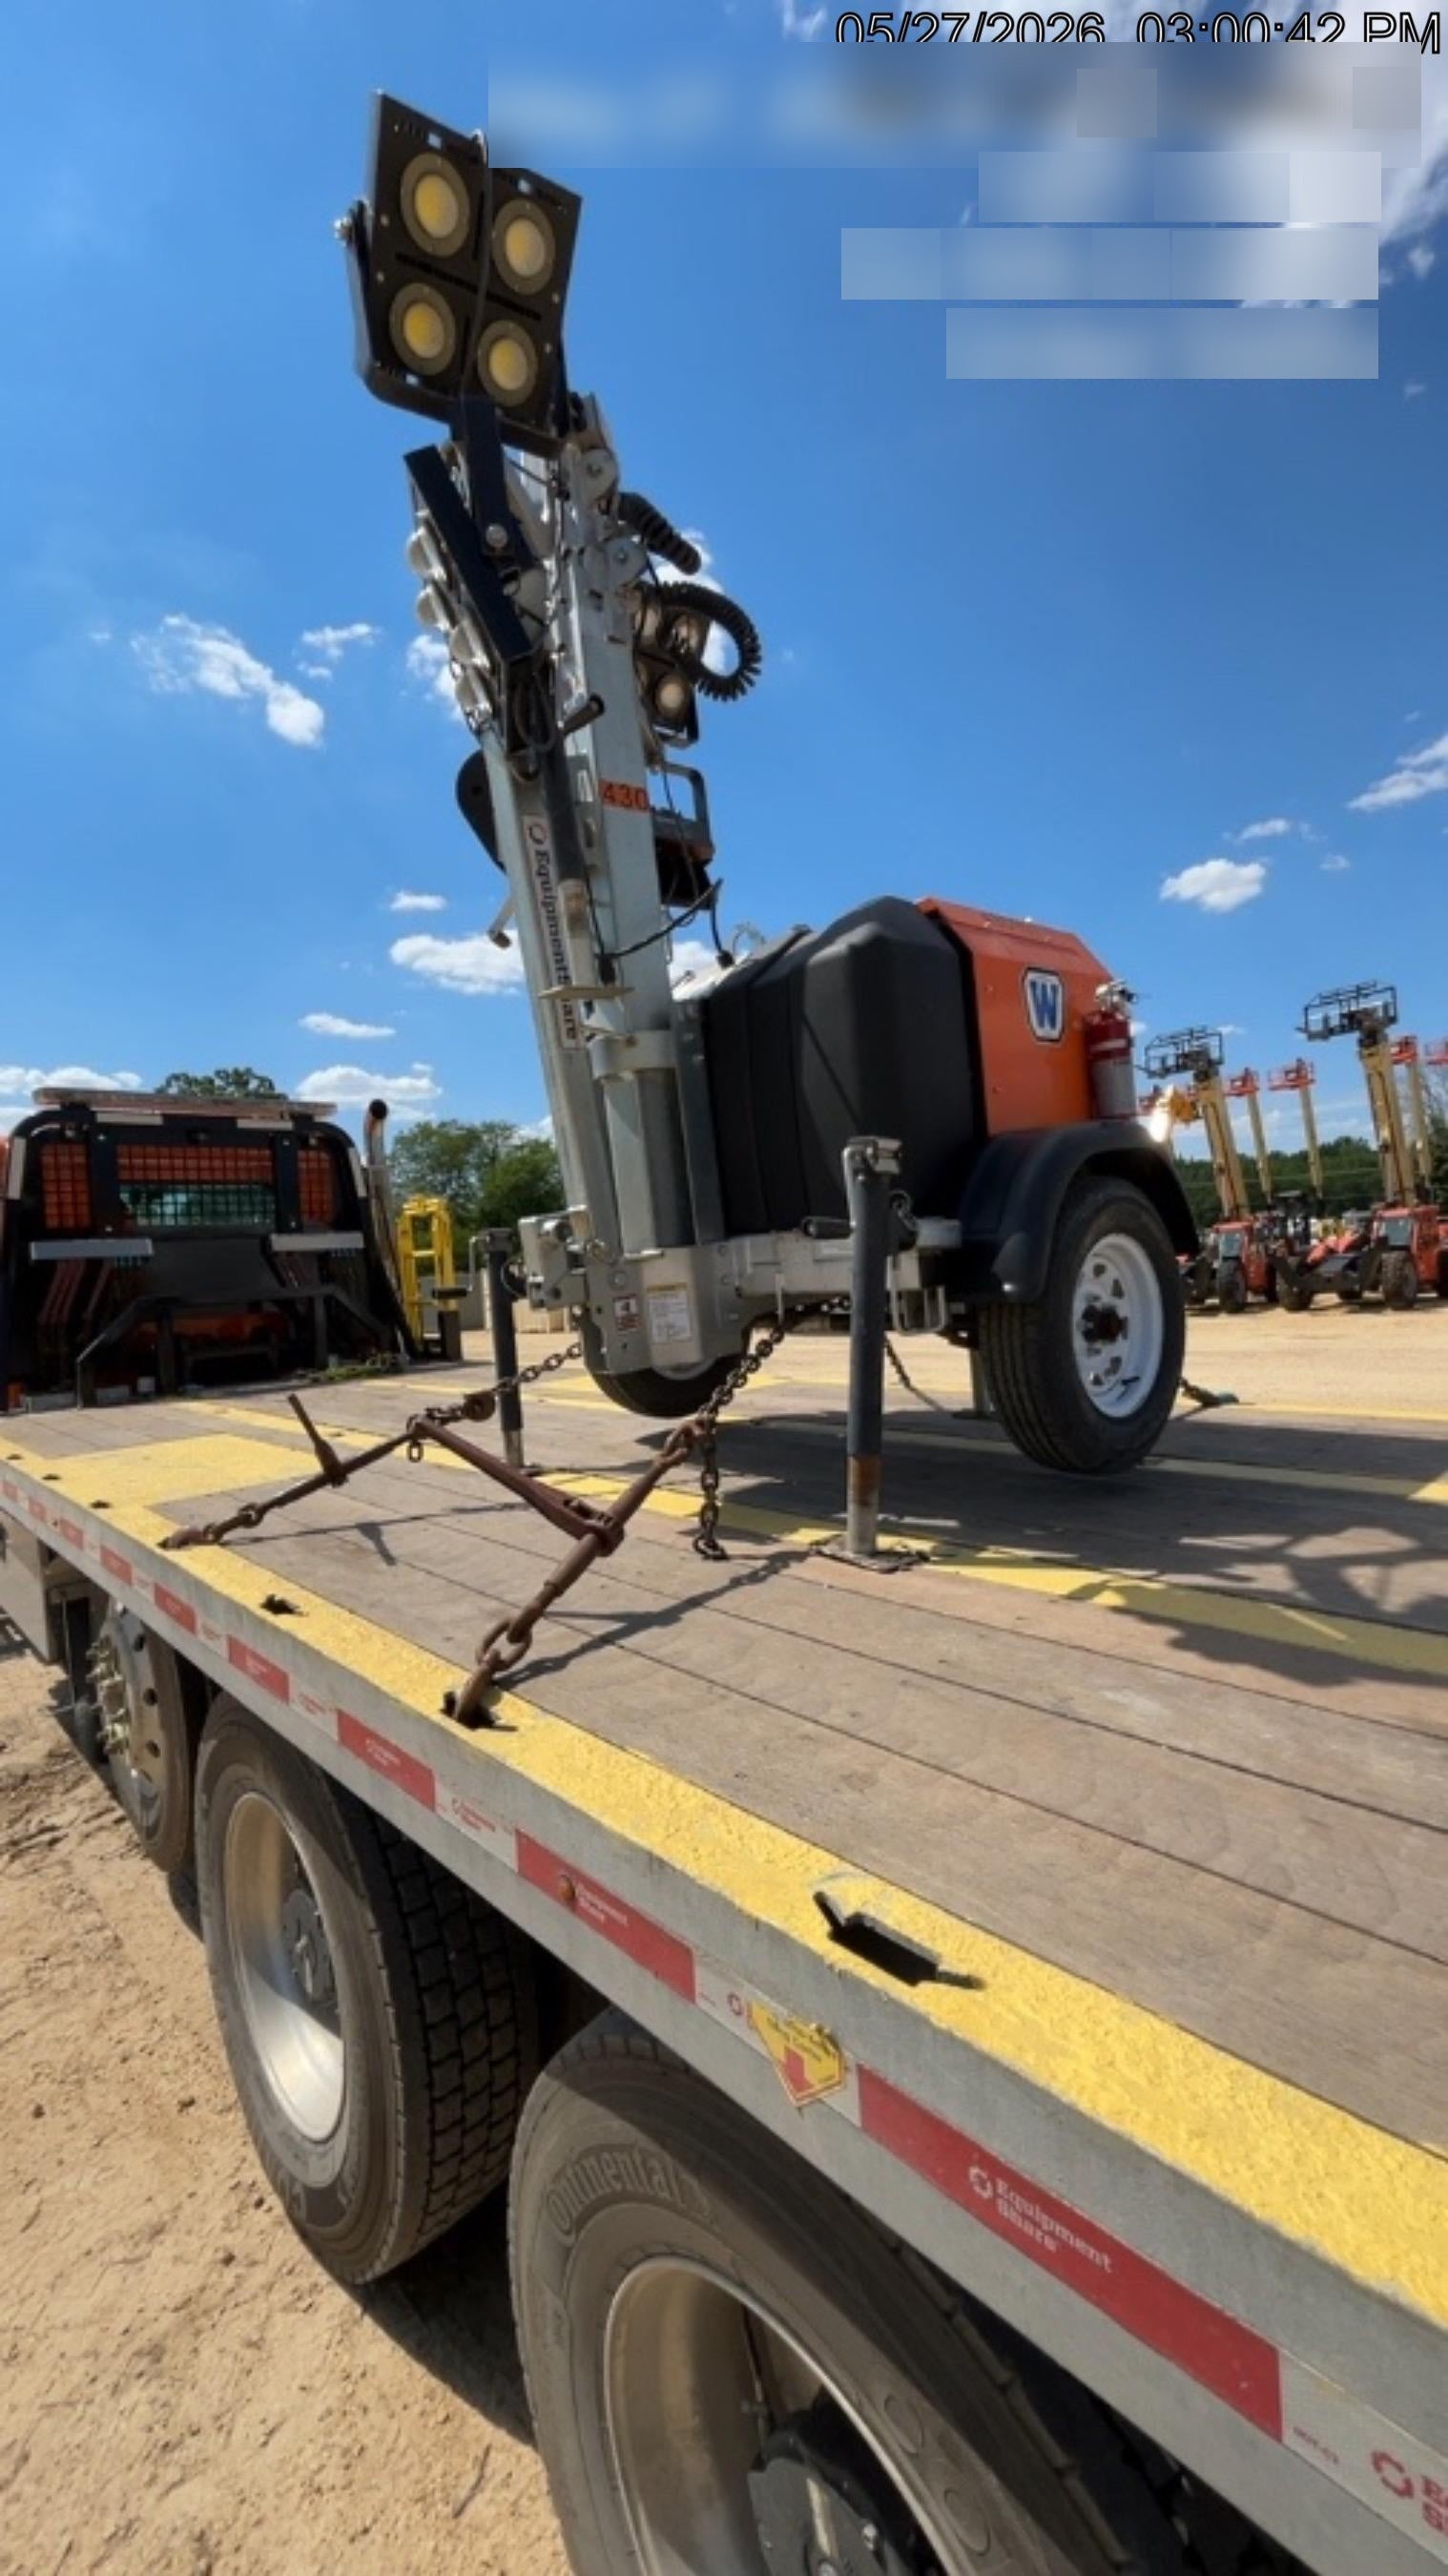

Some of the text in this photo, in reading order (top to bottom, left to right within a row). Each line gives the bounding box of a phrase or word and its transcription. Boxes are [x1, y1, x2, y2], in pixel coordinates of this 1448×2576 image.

[535, 849, 577, 1040] EquipmentSare
[1030, 980, 1061, 1030] W
[996, 2177, 1112, 2274] Equipment
[997, 2195, 1057, 2253] Share
